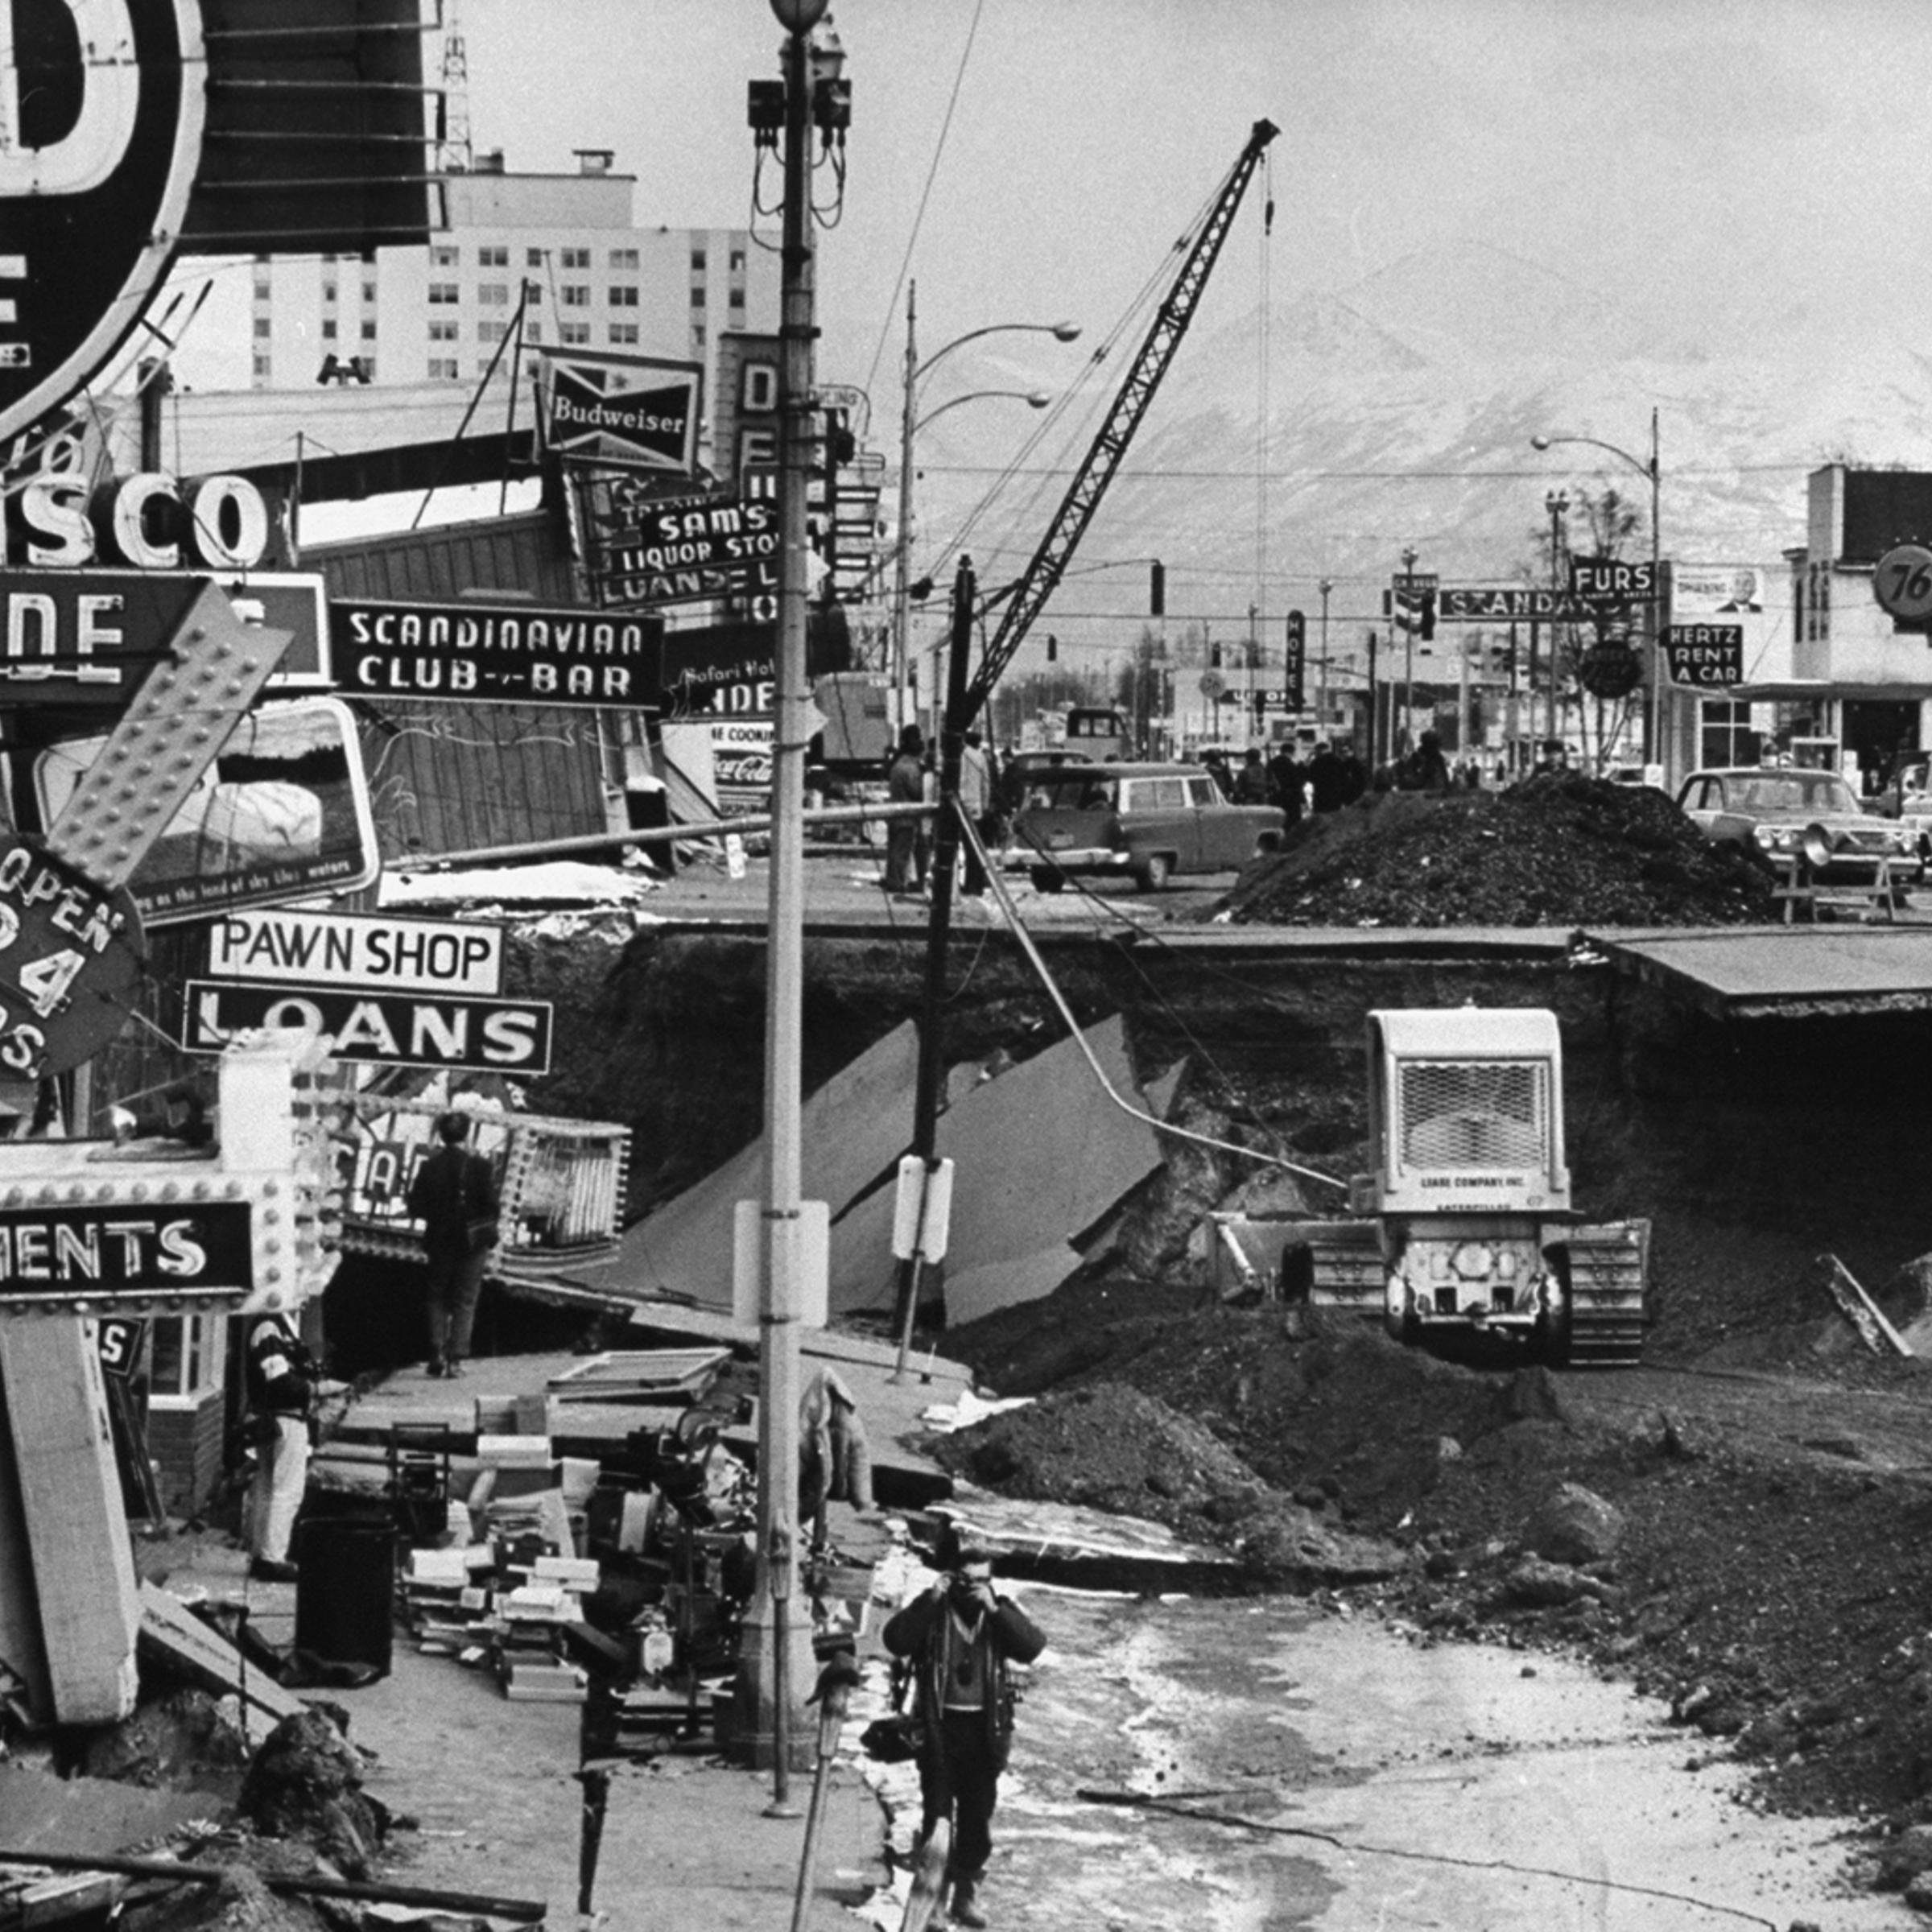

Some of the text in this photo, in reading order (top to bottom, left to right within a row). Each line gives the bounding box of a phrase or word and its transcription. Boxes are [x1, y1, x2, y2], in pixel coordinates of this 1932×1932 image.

[555, 396, 684, 433] Budweiser
[0, 472, 268, 568] SCO
[658, 503, 768, 541] SAM'S
[622, 532, 779, 572] LIQUOR STO
[1575, 565, 1650, 592] FURS
[1891, 563, 1932, 601] 76
[350, 613, 642, 654] SCANDINAVIAN
[1670, 628, 1737, 643] HERTZ
[1675, 647, 1736, 663] RENT
[1677, 666, 1738, 682] A CAR
[0, 848, 125, 954] OPEN
[221, 920, 490, 980] PAWN SHOP
[198, 991, 538, 1063] LOANS
[100, 1324, 127, 1364] S
